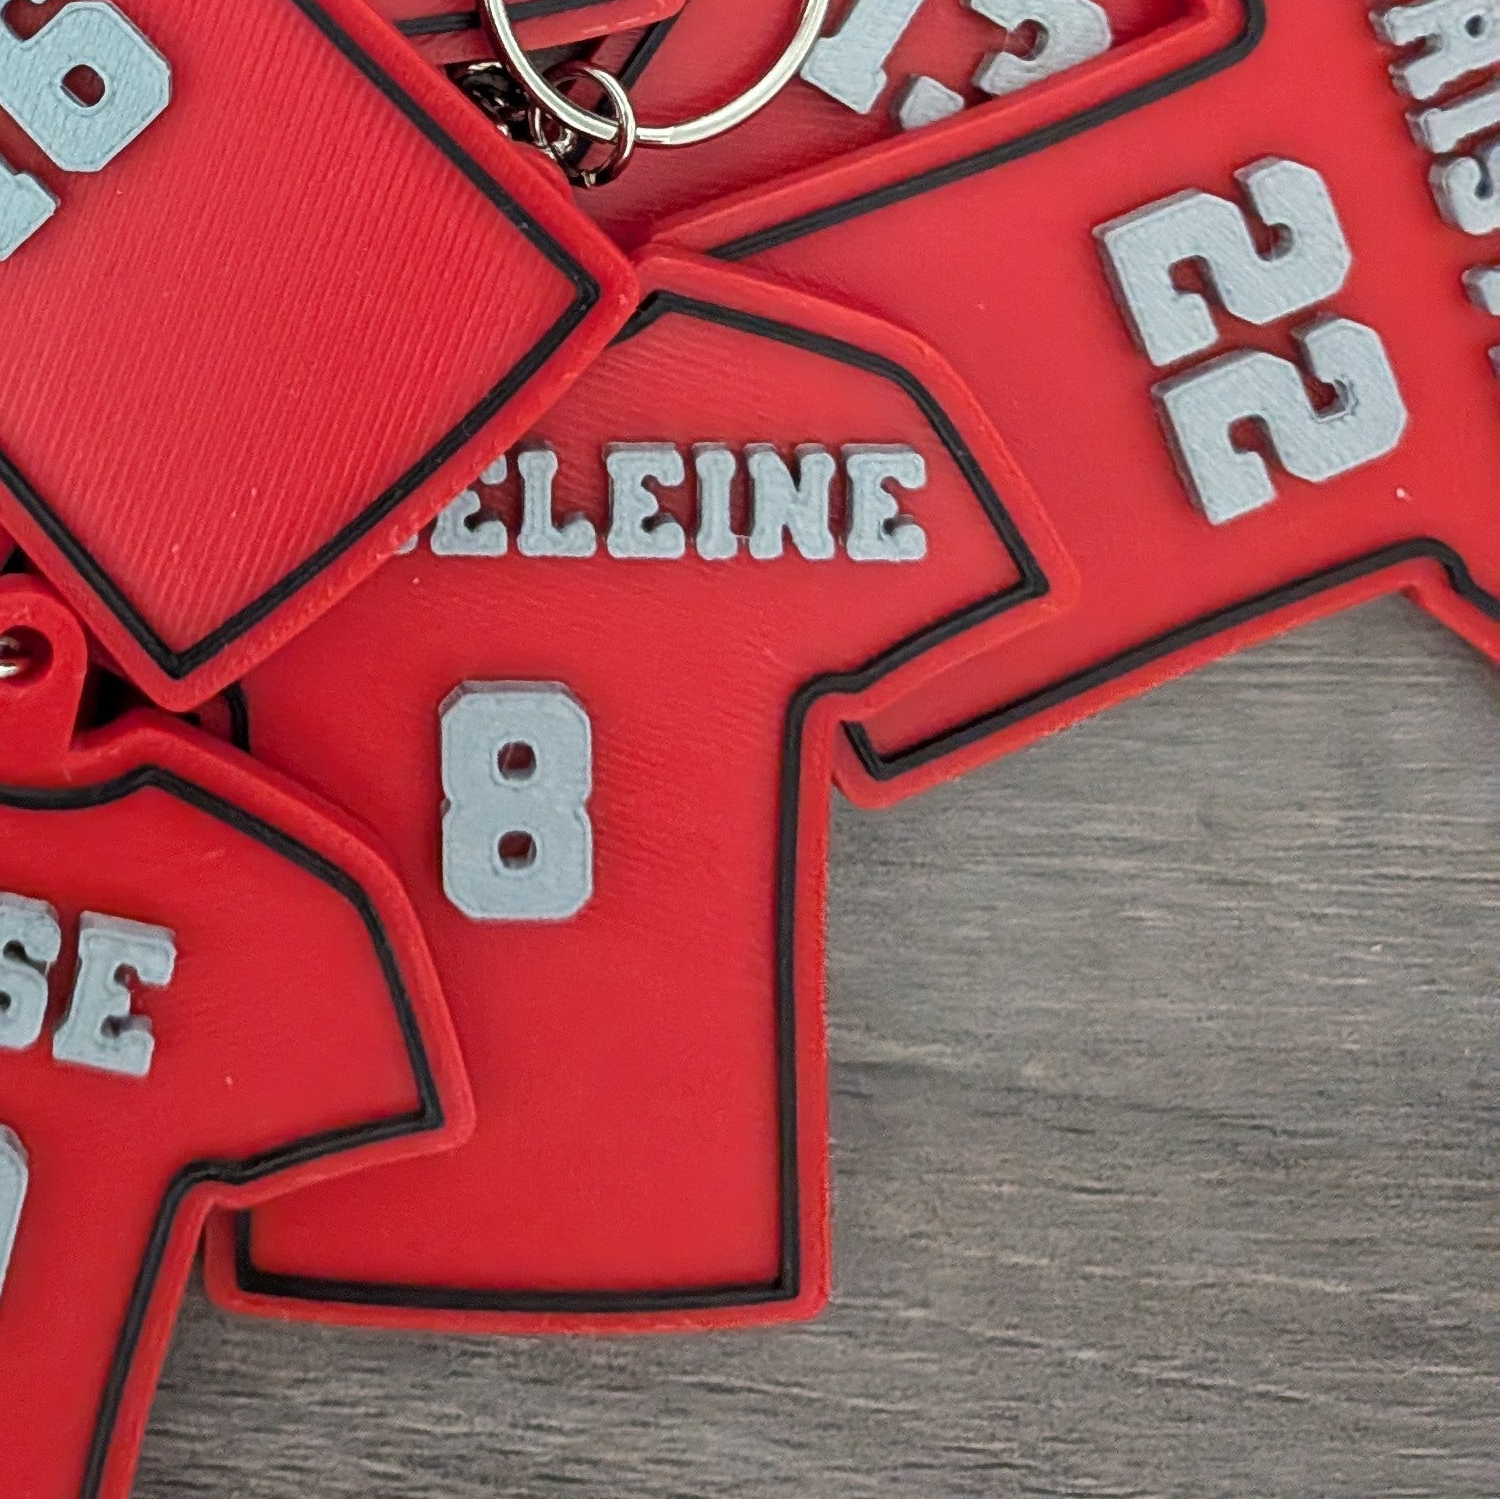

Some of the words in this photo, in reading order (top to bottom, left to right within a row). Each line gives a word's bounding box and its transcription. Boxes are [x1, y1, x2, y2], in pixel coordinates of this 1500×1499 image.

[1093, 154, 1410, 526] 22
[393, 442, 927, 561] ELEINE
[438, 679, 593, 921] 8
